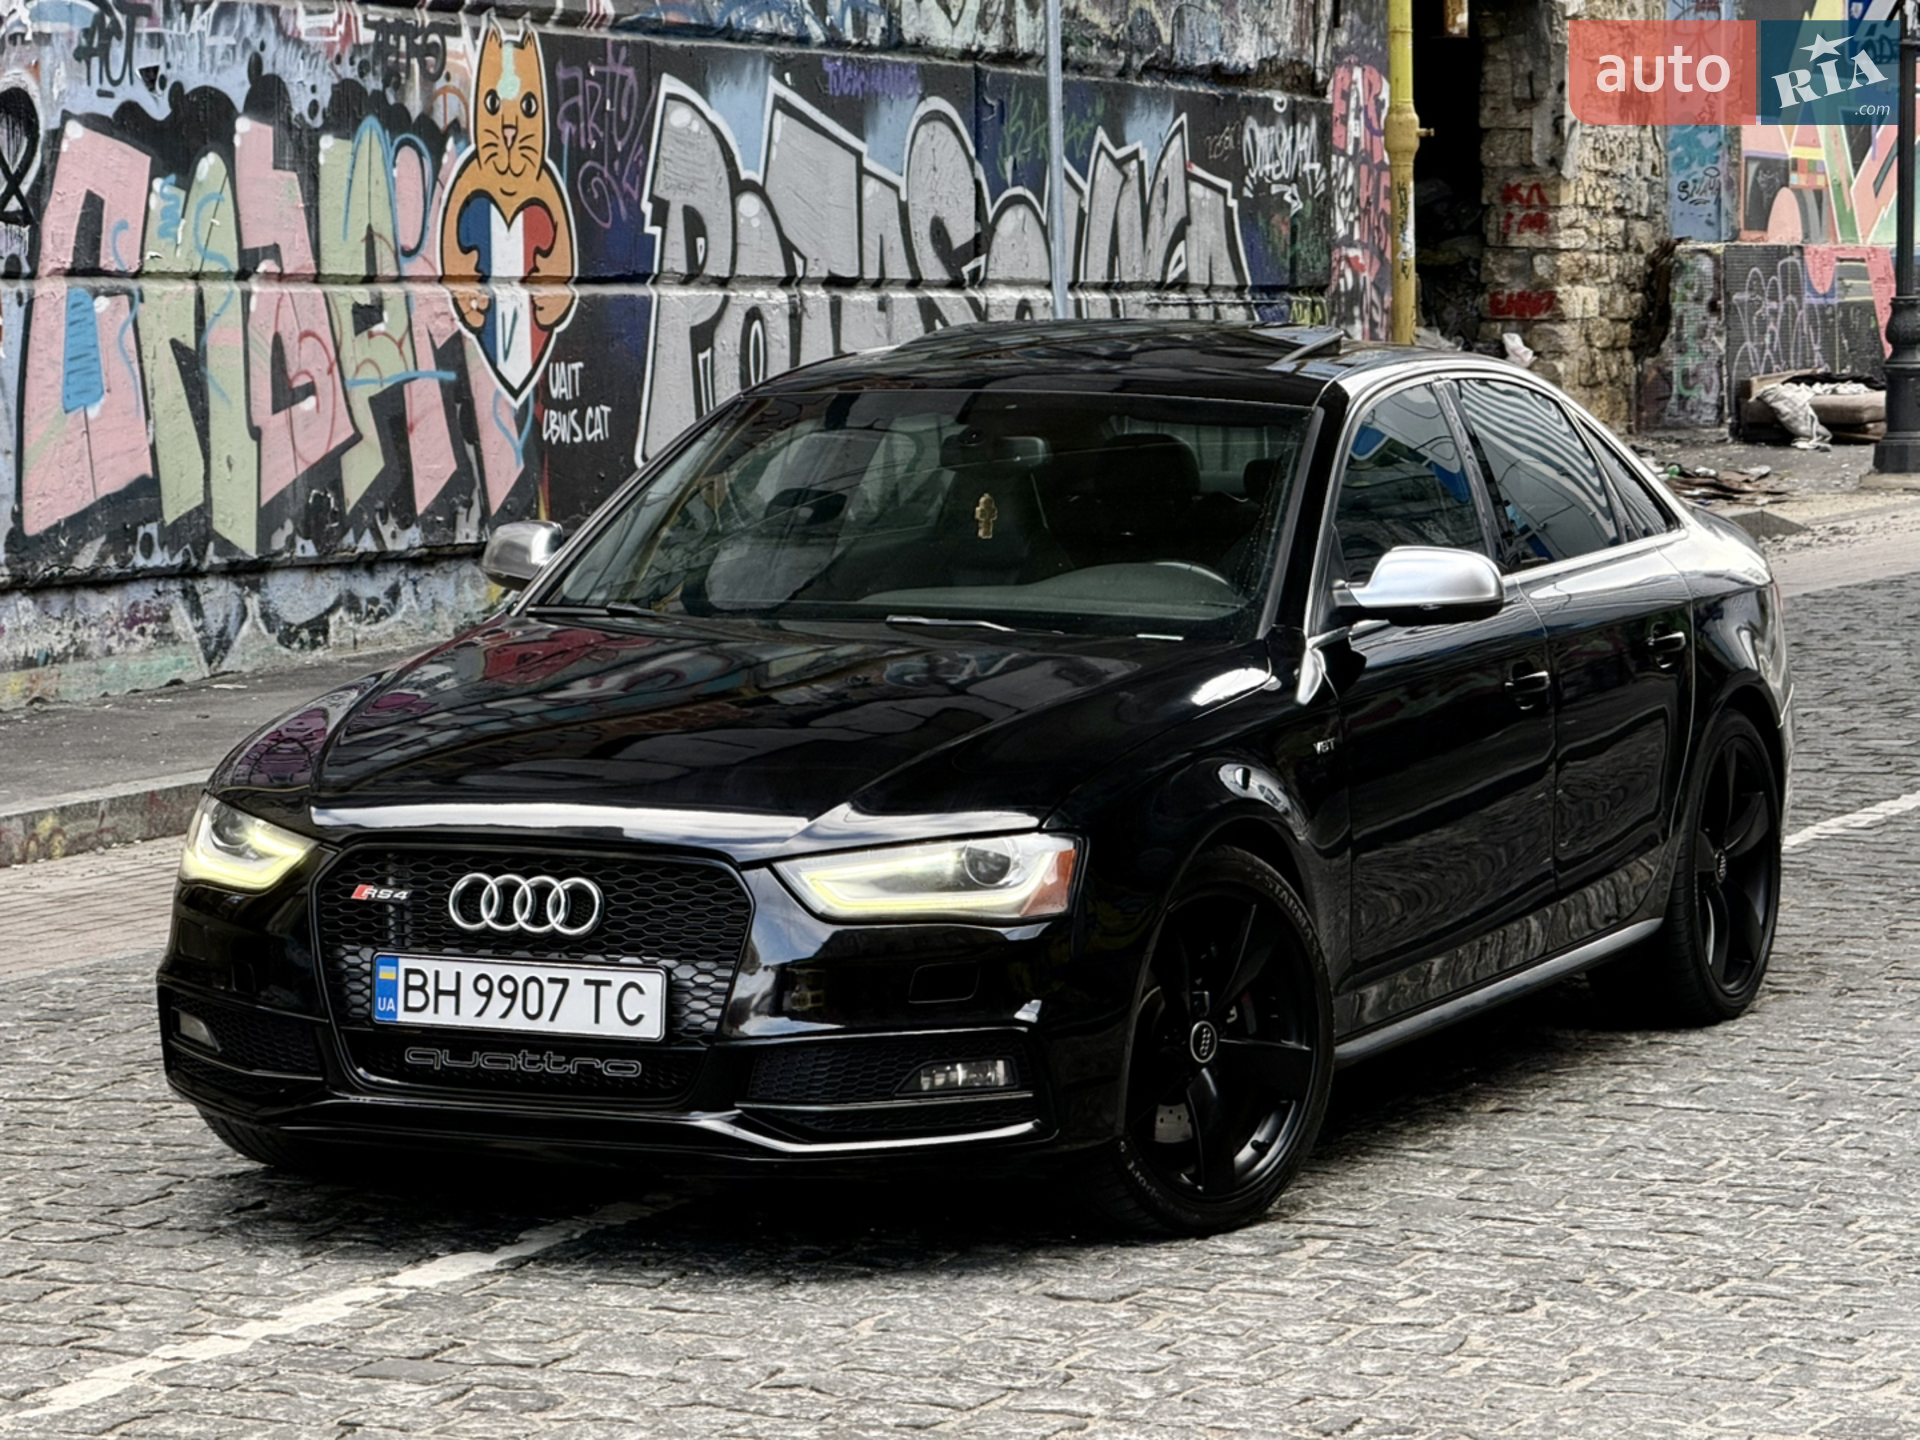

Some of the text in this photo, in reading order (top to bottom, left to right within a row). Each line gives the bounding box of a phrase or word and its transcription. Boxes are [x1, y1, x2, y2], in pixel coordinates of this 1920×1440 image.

[584, 404, 612, 442] CAT
[352, 884, 409, 900] RS4
[377, 996, 396, 1012] UA
[403, 967, 646, 1027] BH 9907 TC
[404, 1046, 642, 1078] quattro
